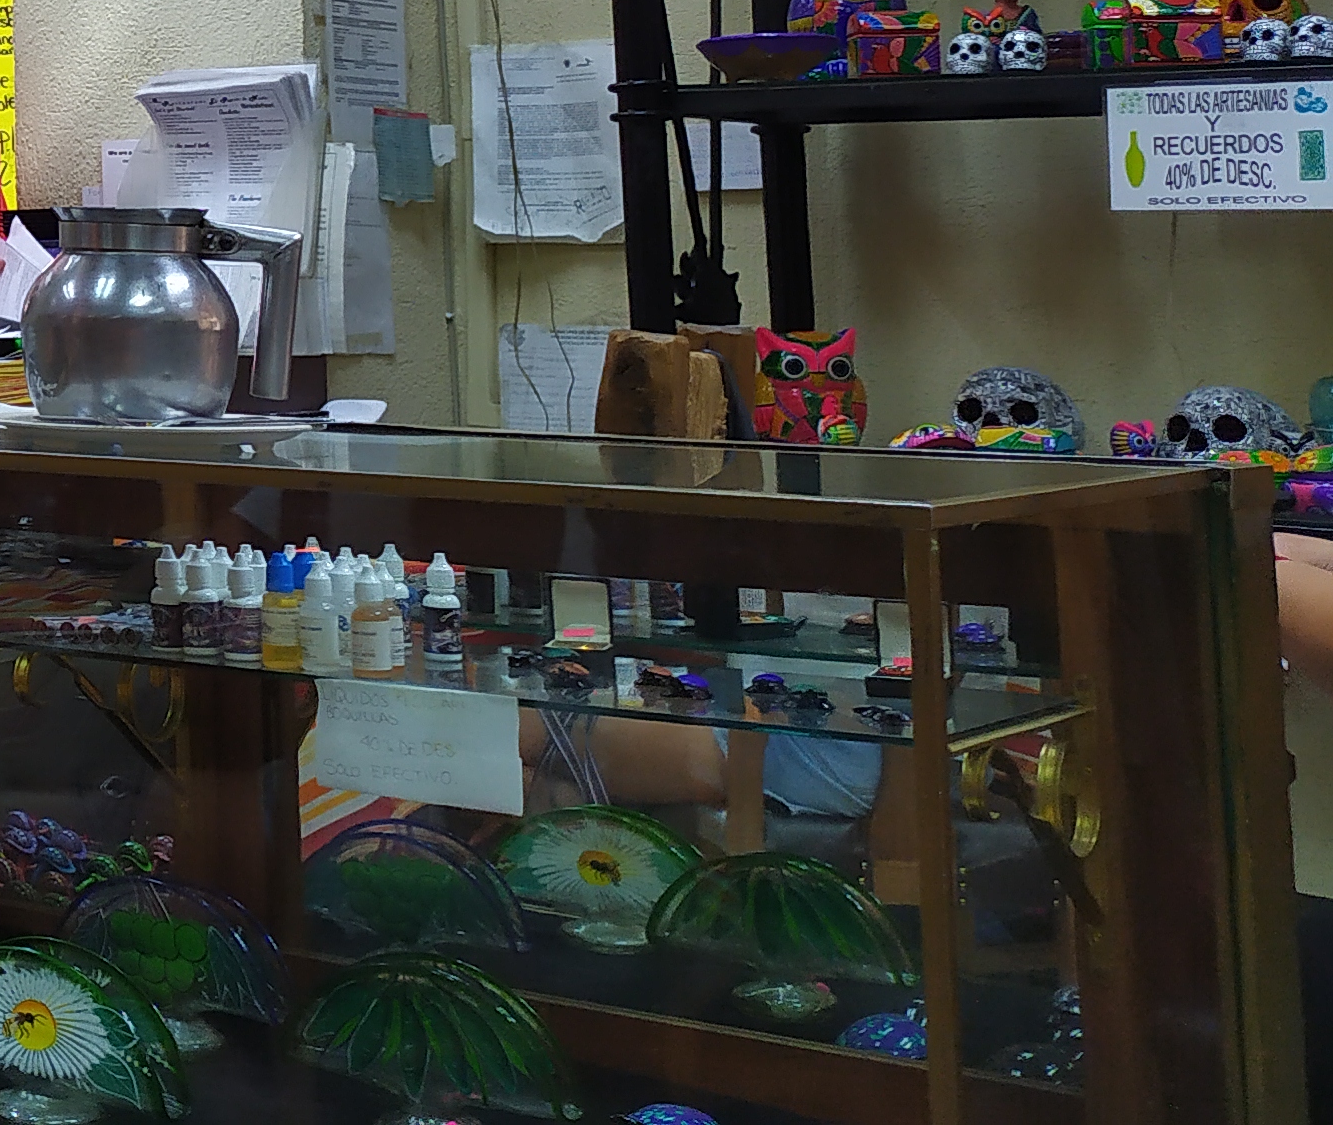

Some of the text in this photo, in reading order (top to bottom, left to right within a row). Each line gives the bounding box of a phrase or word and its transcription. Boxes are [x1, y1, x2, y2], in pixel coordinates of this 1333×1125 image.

[1146, 88, 1288, 115] TODAS LAS ARTESANIAS
[1204, 115, 1221, 132] Y
[1153, 133, 1284, 156] RECUERDOS
[1165, 157, 1277, 190] 40% DE DESC.
[1148, 194, 1307, 206] SOLO EFECTIVO
[323, 758, 361, 778] SOLO
